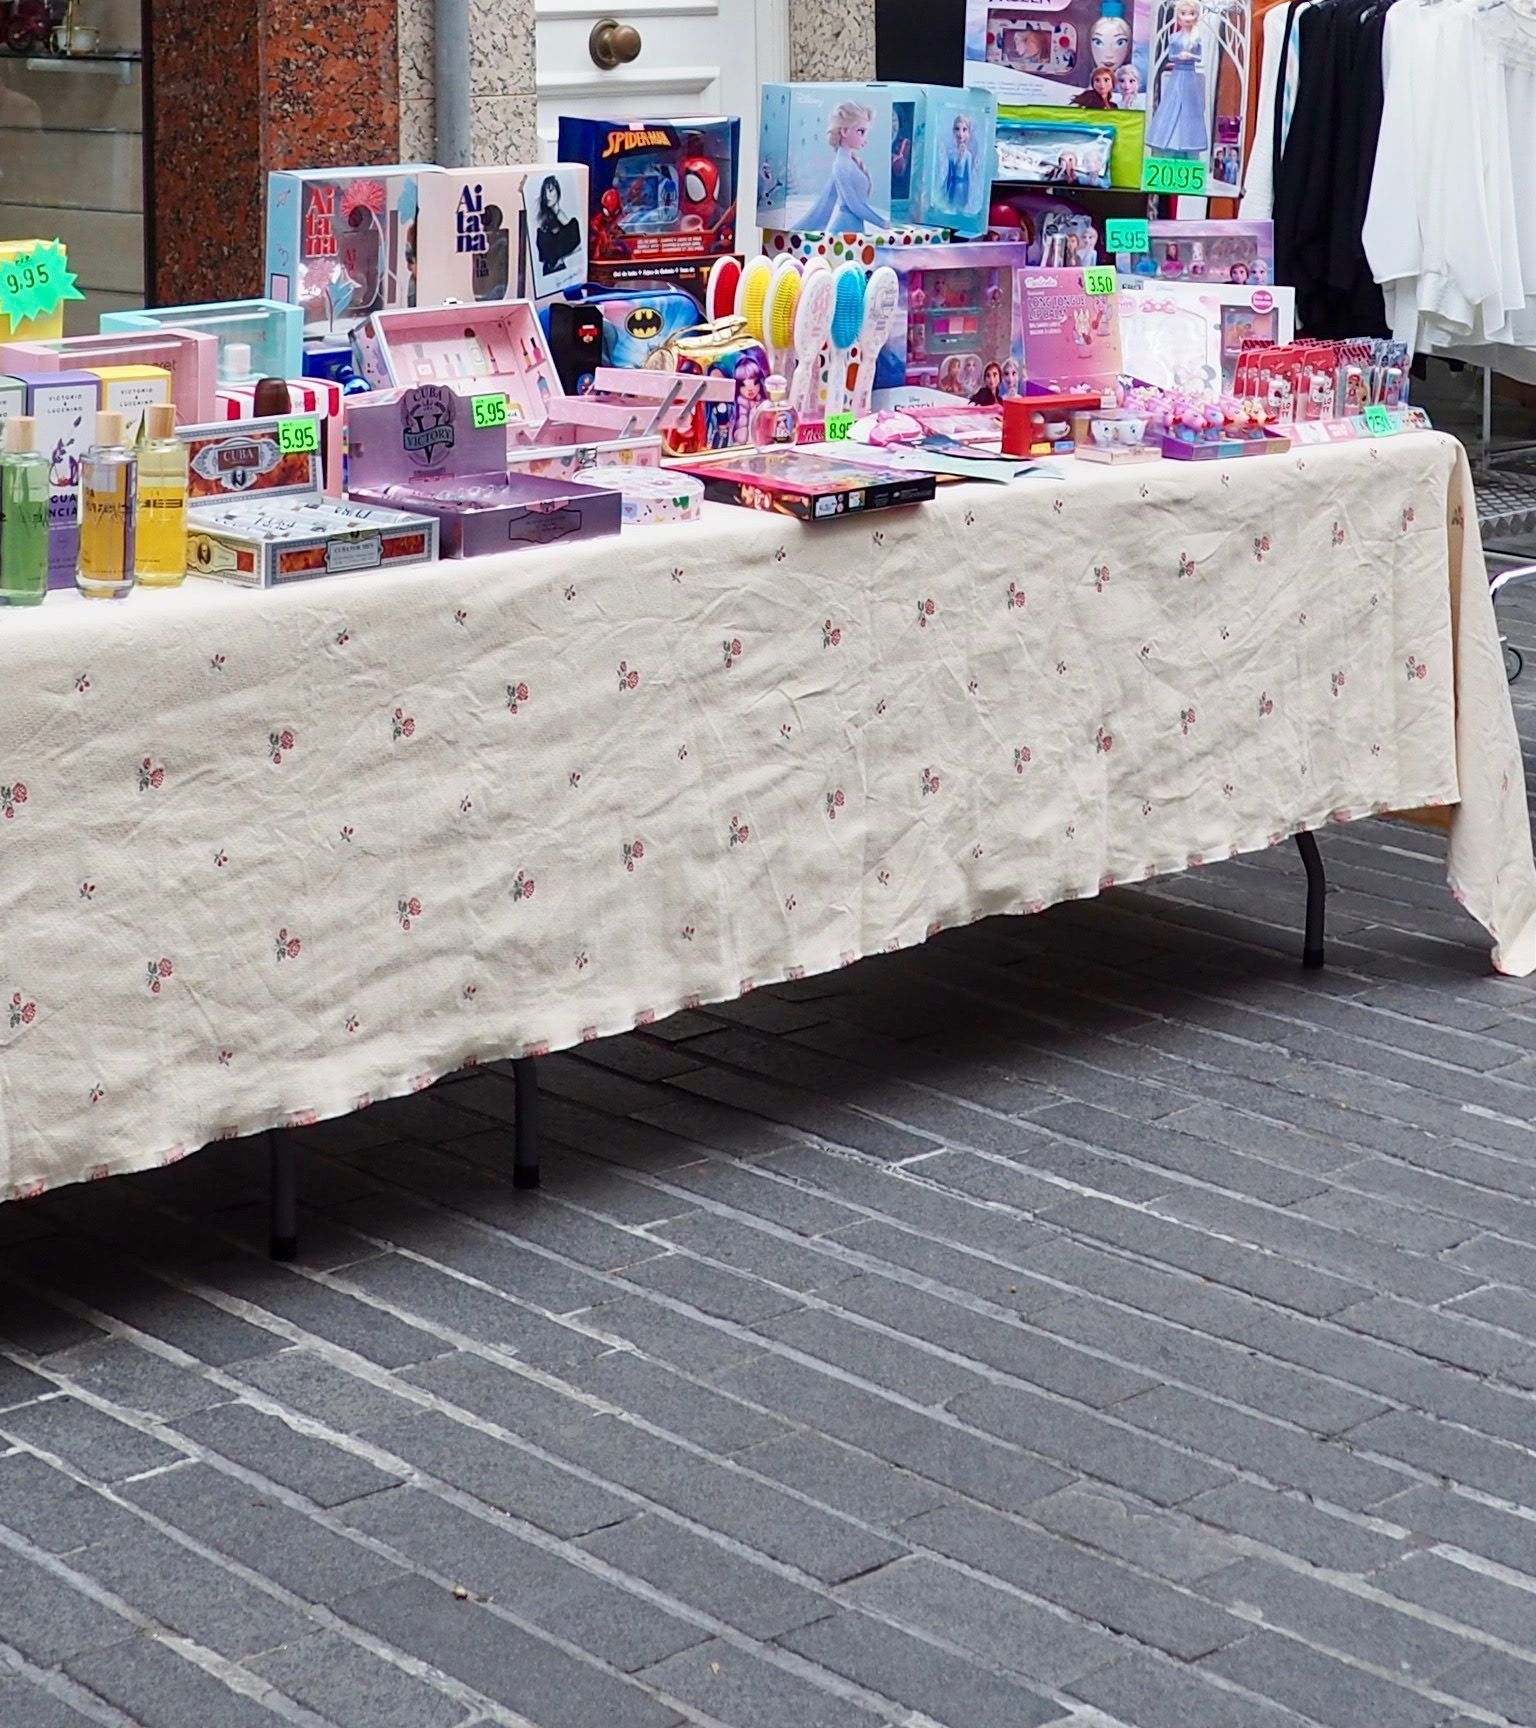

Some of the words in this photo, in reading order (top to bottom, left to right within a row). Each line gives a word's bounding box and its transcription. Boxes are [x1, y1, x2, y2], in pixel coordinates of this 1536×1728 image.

[307, 187, 336, 215] Ai
[457, 184, 482, 212] Ai
[306, 214, 331, 236] ta
[457, 210, 482, 233] ta
[306, 235, 338, 256] na
[457, 233, 488, 253] na
[7, 264, 49, 294] 9.95
[1089, 276, 1113, 293] 3.50
[413, 387, 442, 402] CUBA
[475, 400, 506, 425] 5.95
[281, 426, 315, 450] 5.95
[407, 429, 453, 447] VICTORY
[223, 449, 254, 462] CUBA
